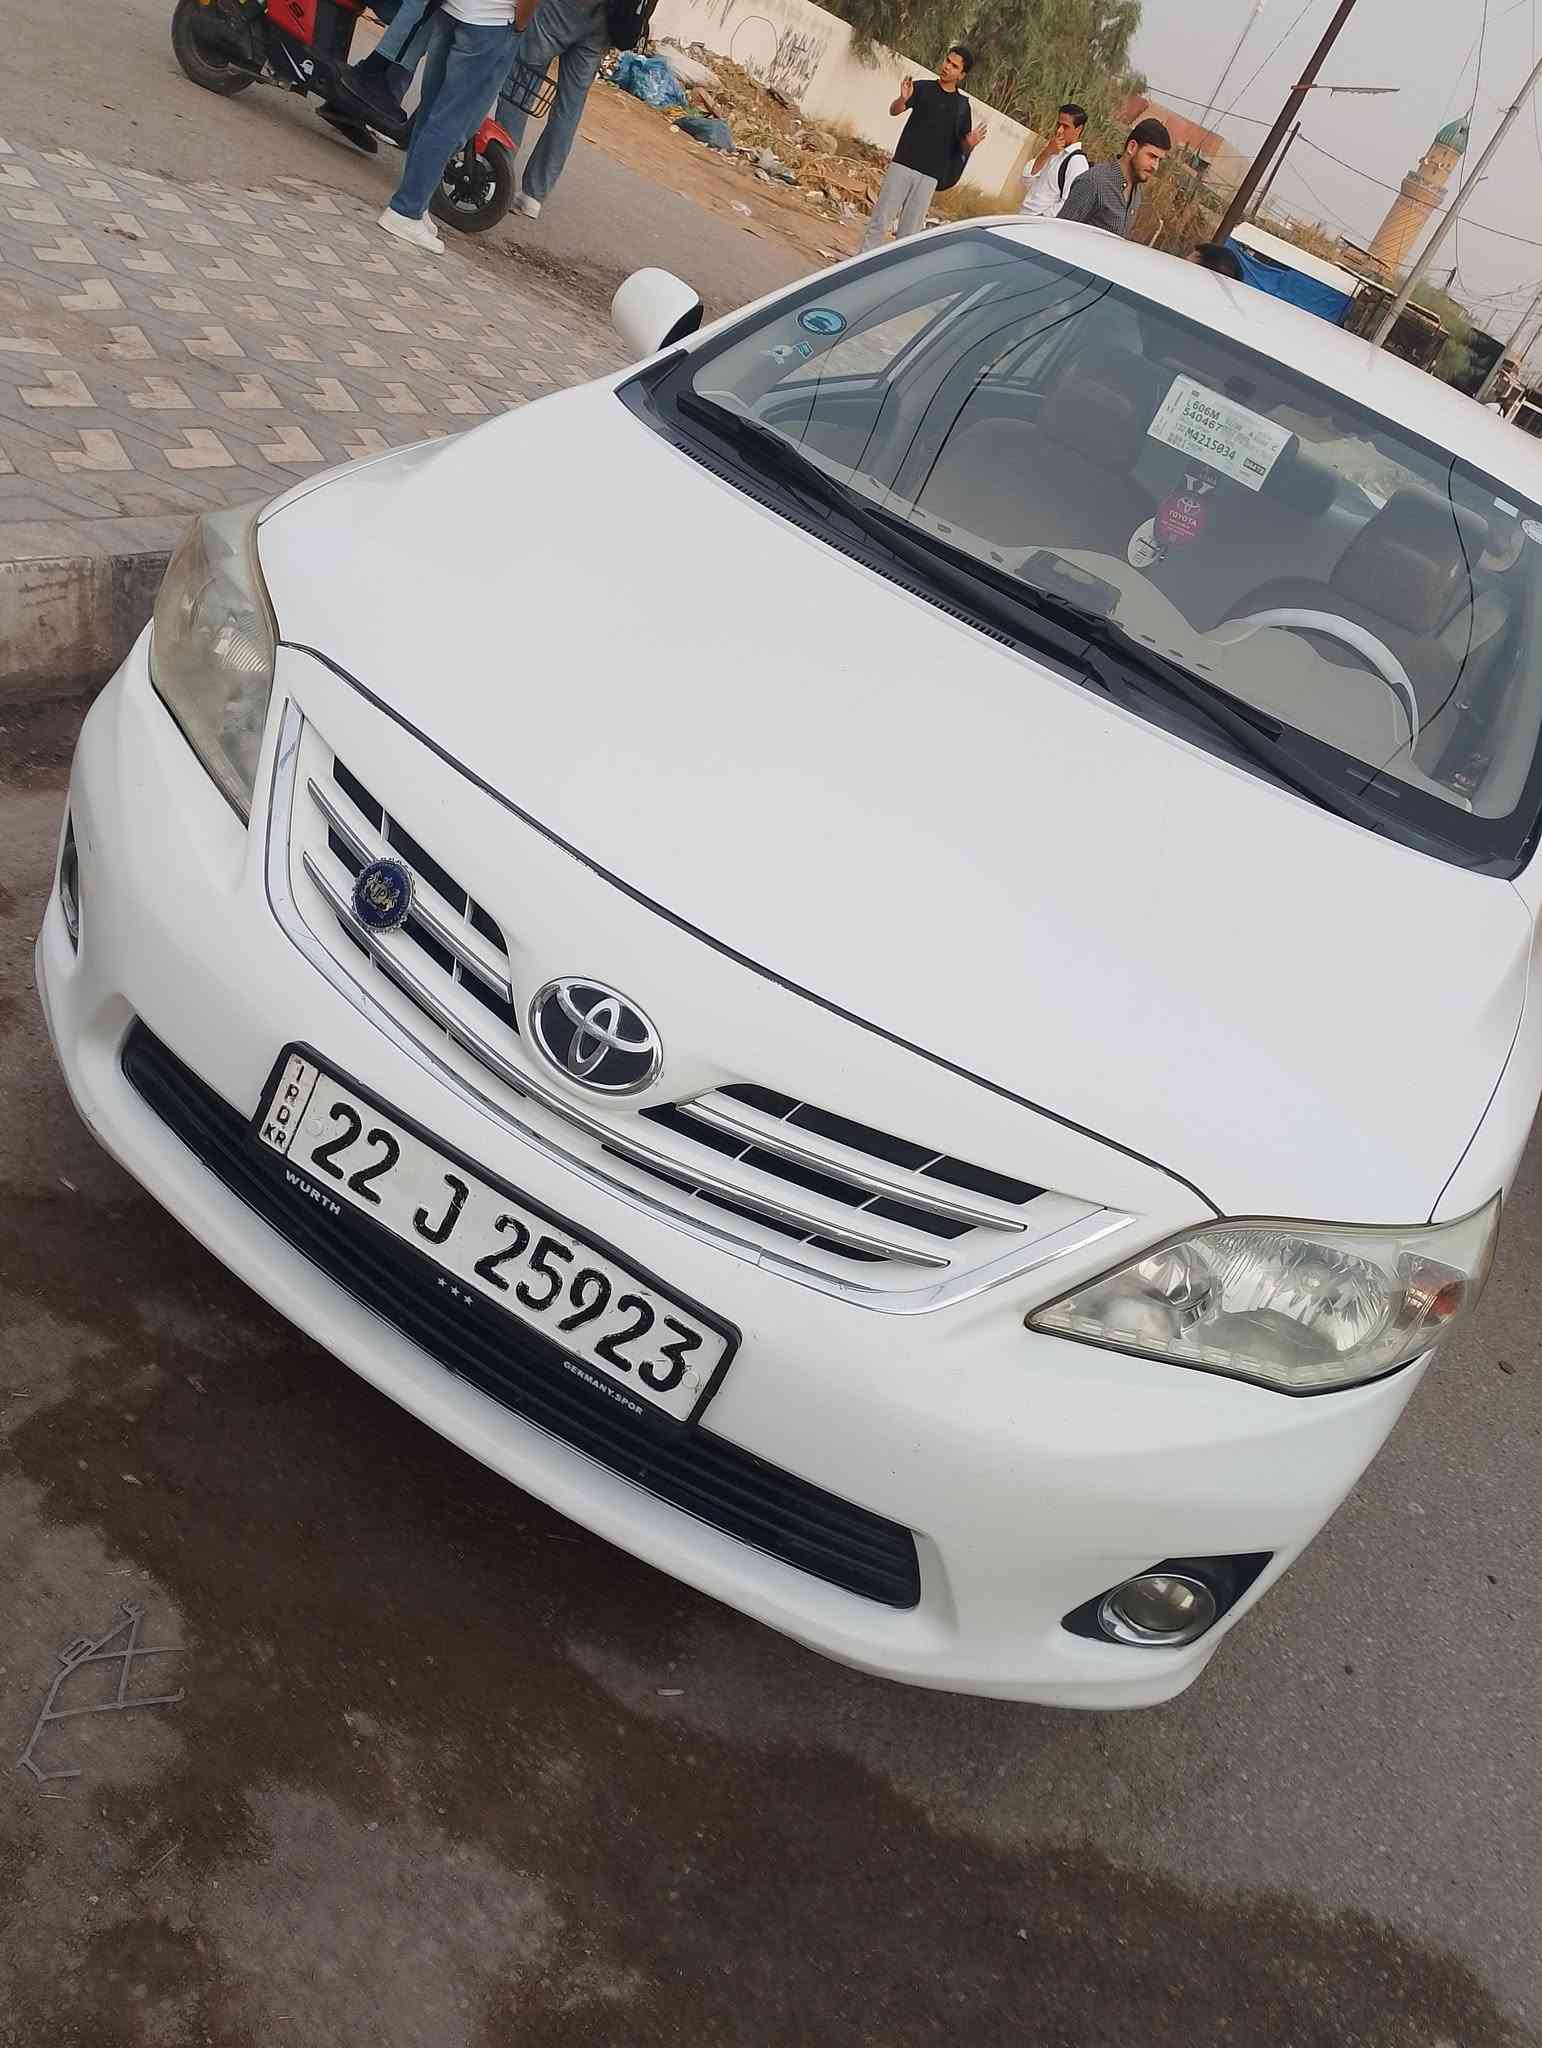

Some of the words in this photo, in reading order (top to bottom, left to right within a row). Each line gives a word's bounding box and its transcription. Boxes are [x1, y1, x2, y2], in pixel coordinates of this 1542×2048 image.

[263, 1122, 287, 1147] KR
[286, 1169, 341, 1216] WURTH
[310, 1101, 401, 1206] 22
[412, 1173, 470, 1245] J
[473, 1213, 703, 1393] 25923
